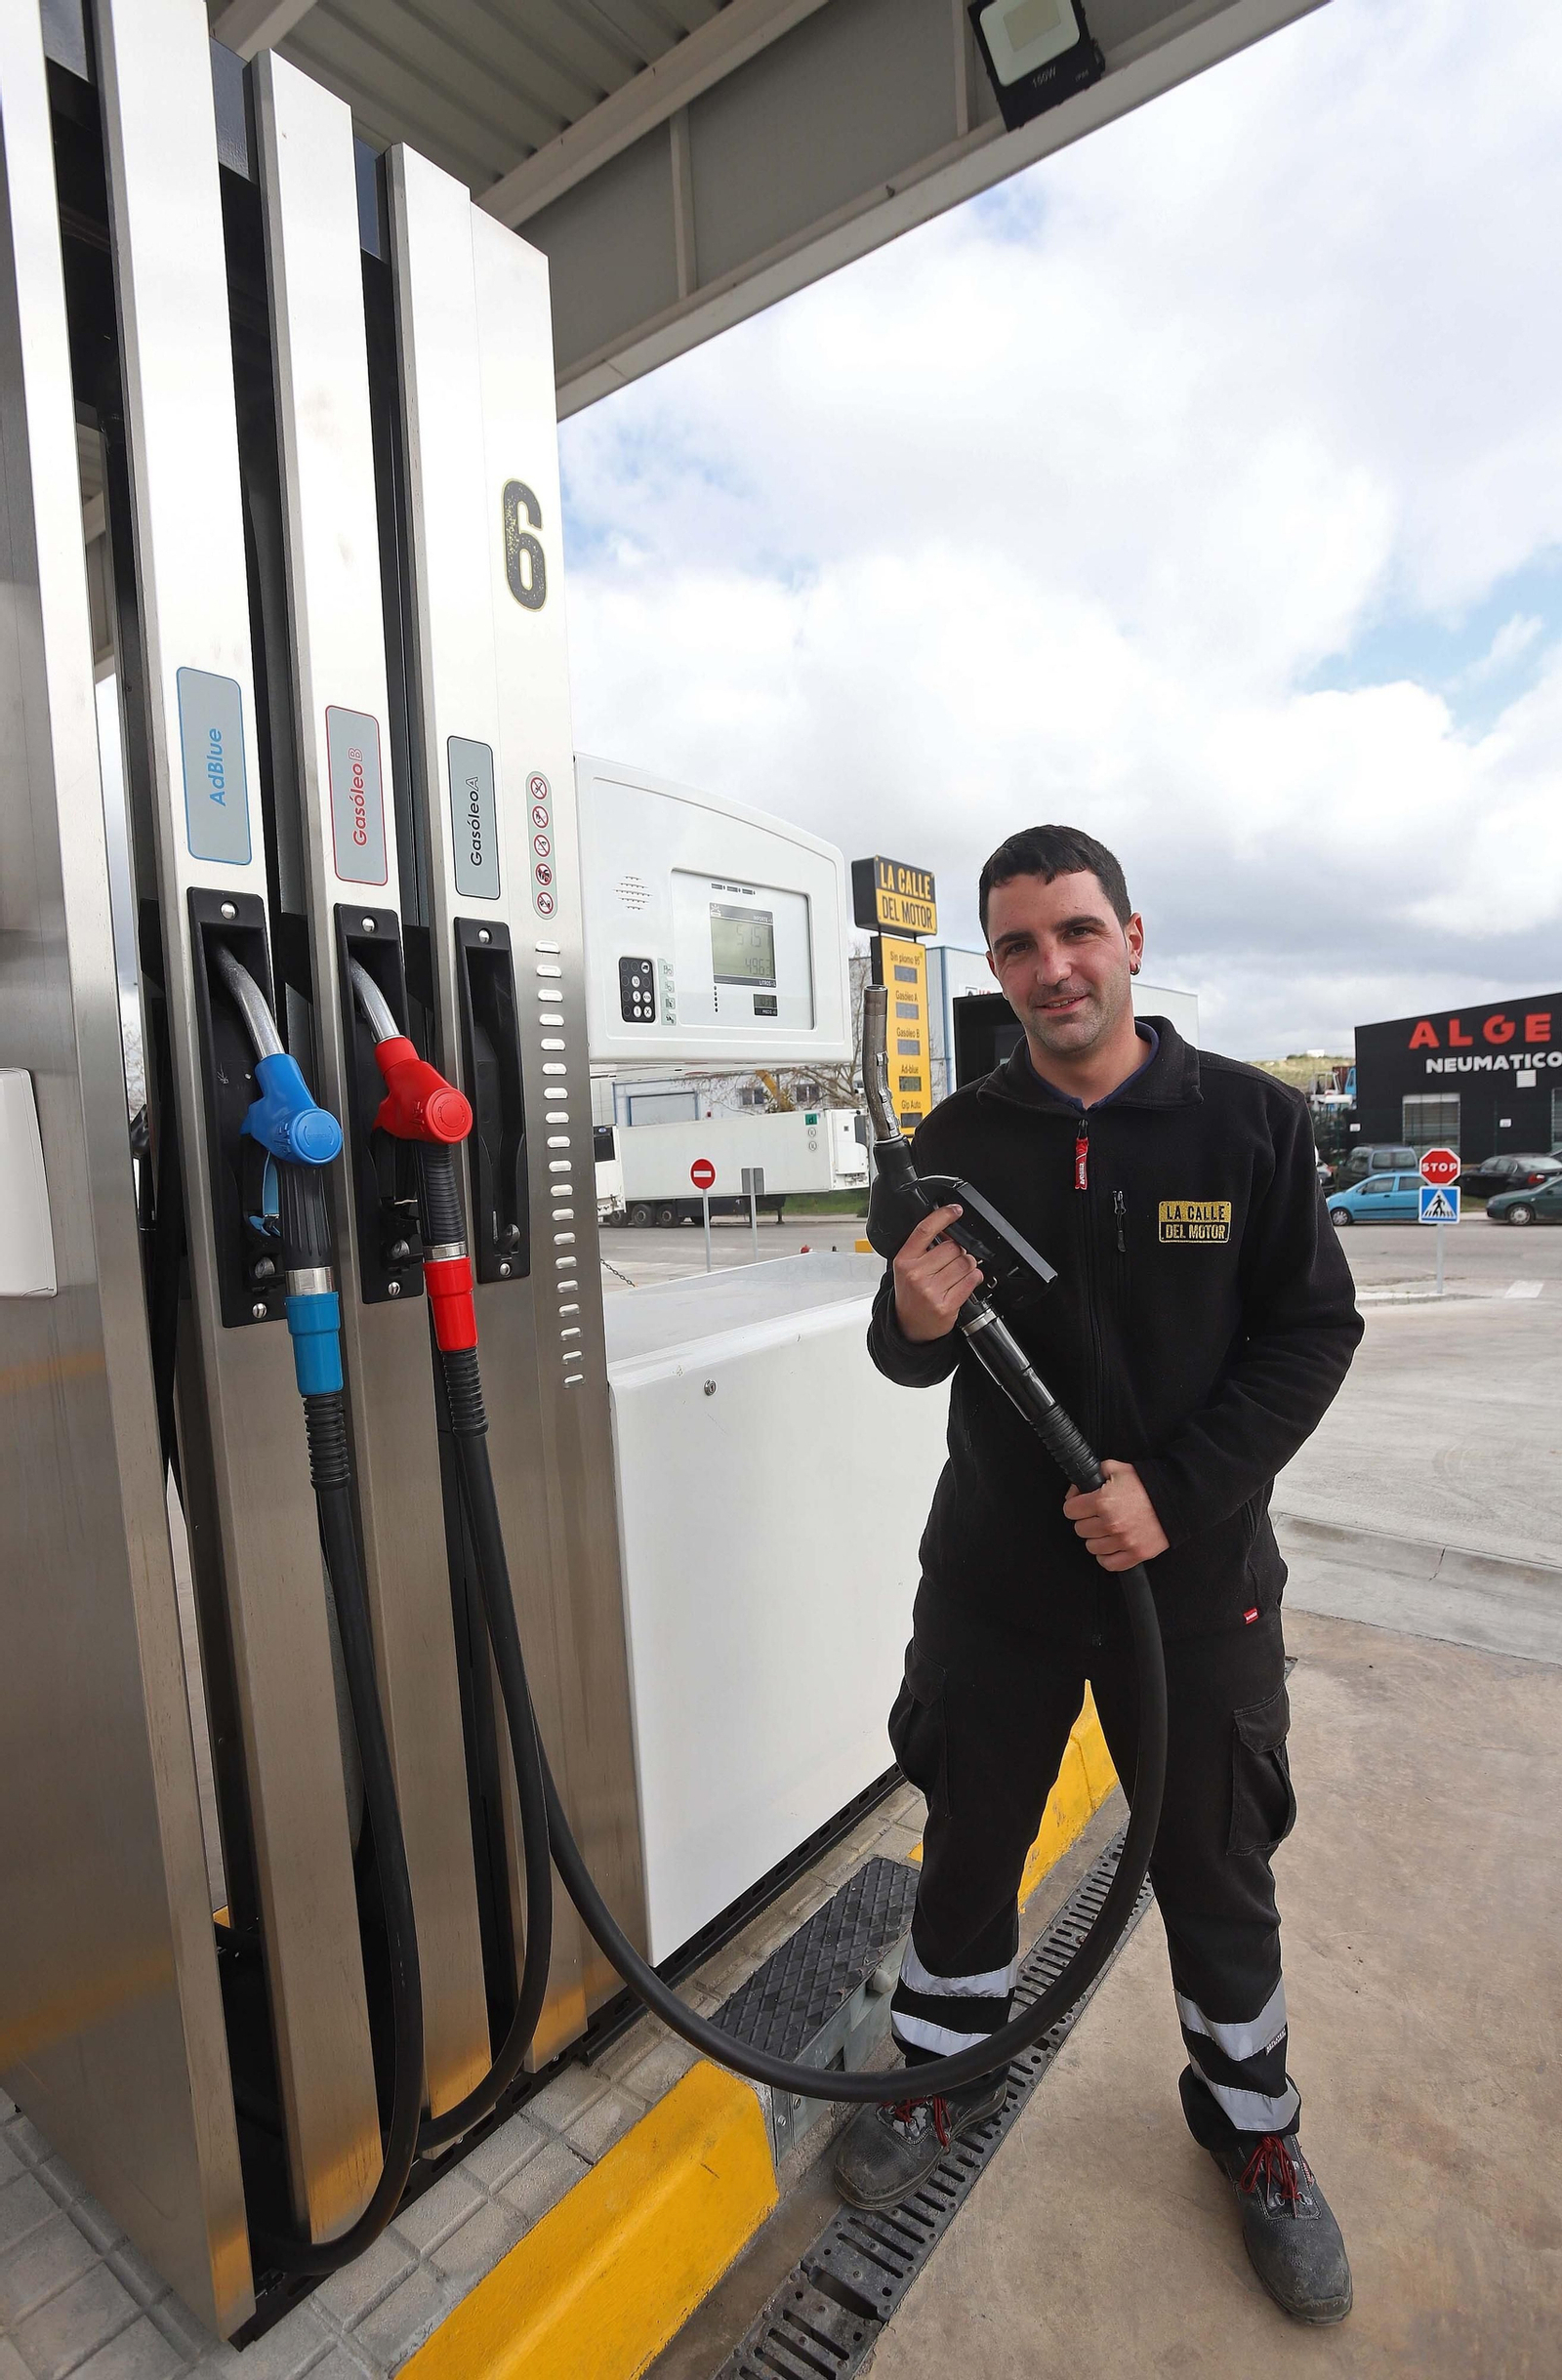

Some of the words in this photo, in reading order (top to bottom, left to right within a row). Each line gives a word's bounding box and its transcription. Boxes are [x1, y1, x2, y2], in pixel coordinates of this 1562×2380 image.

[501, 478, 547, 611] 6
[209, 727, 226, 806] AdBlue
[881, 862, 895, 890] LA
[898, 868, 931, 900] CALLE
[883, 895, 900, 922] DEL
[902, 900, 932, 929] MOTOR
[916, 1028, 920, 1039] B
[1409, 1012, 1551, 1049] ALGE
[1425, 1050, 1562, 1074] NEUMATICO
[1422, 1162, 1458, 1172] STOP
[1167, 1205, 1181, 1220] LA
[1188, 1205, 1225, 1220] CALLE
[1166, 1223, 1186, 1239] DEL
[1188, 1223, 1226, 1239] MOTOR
